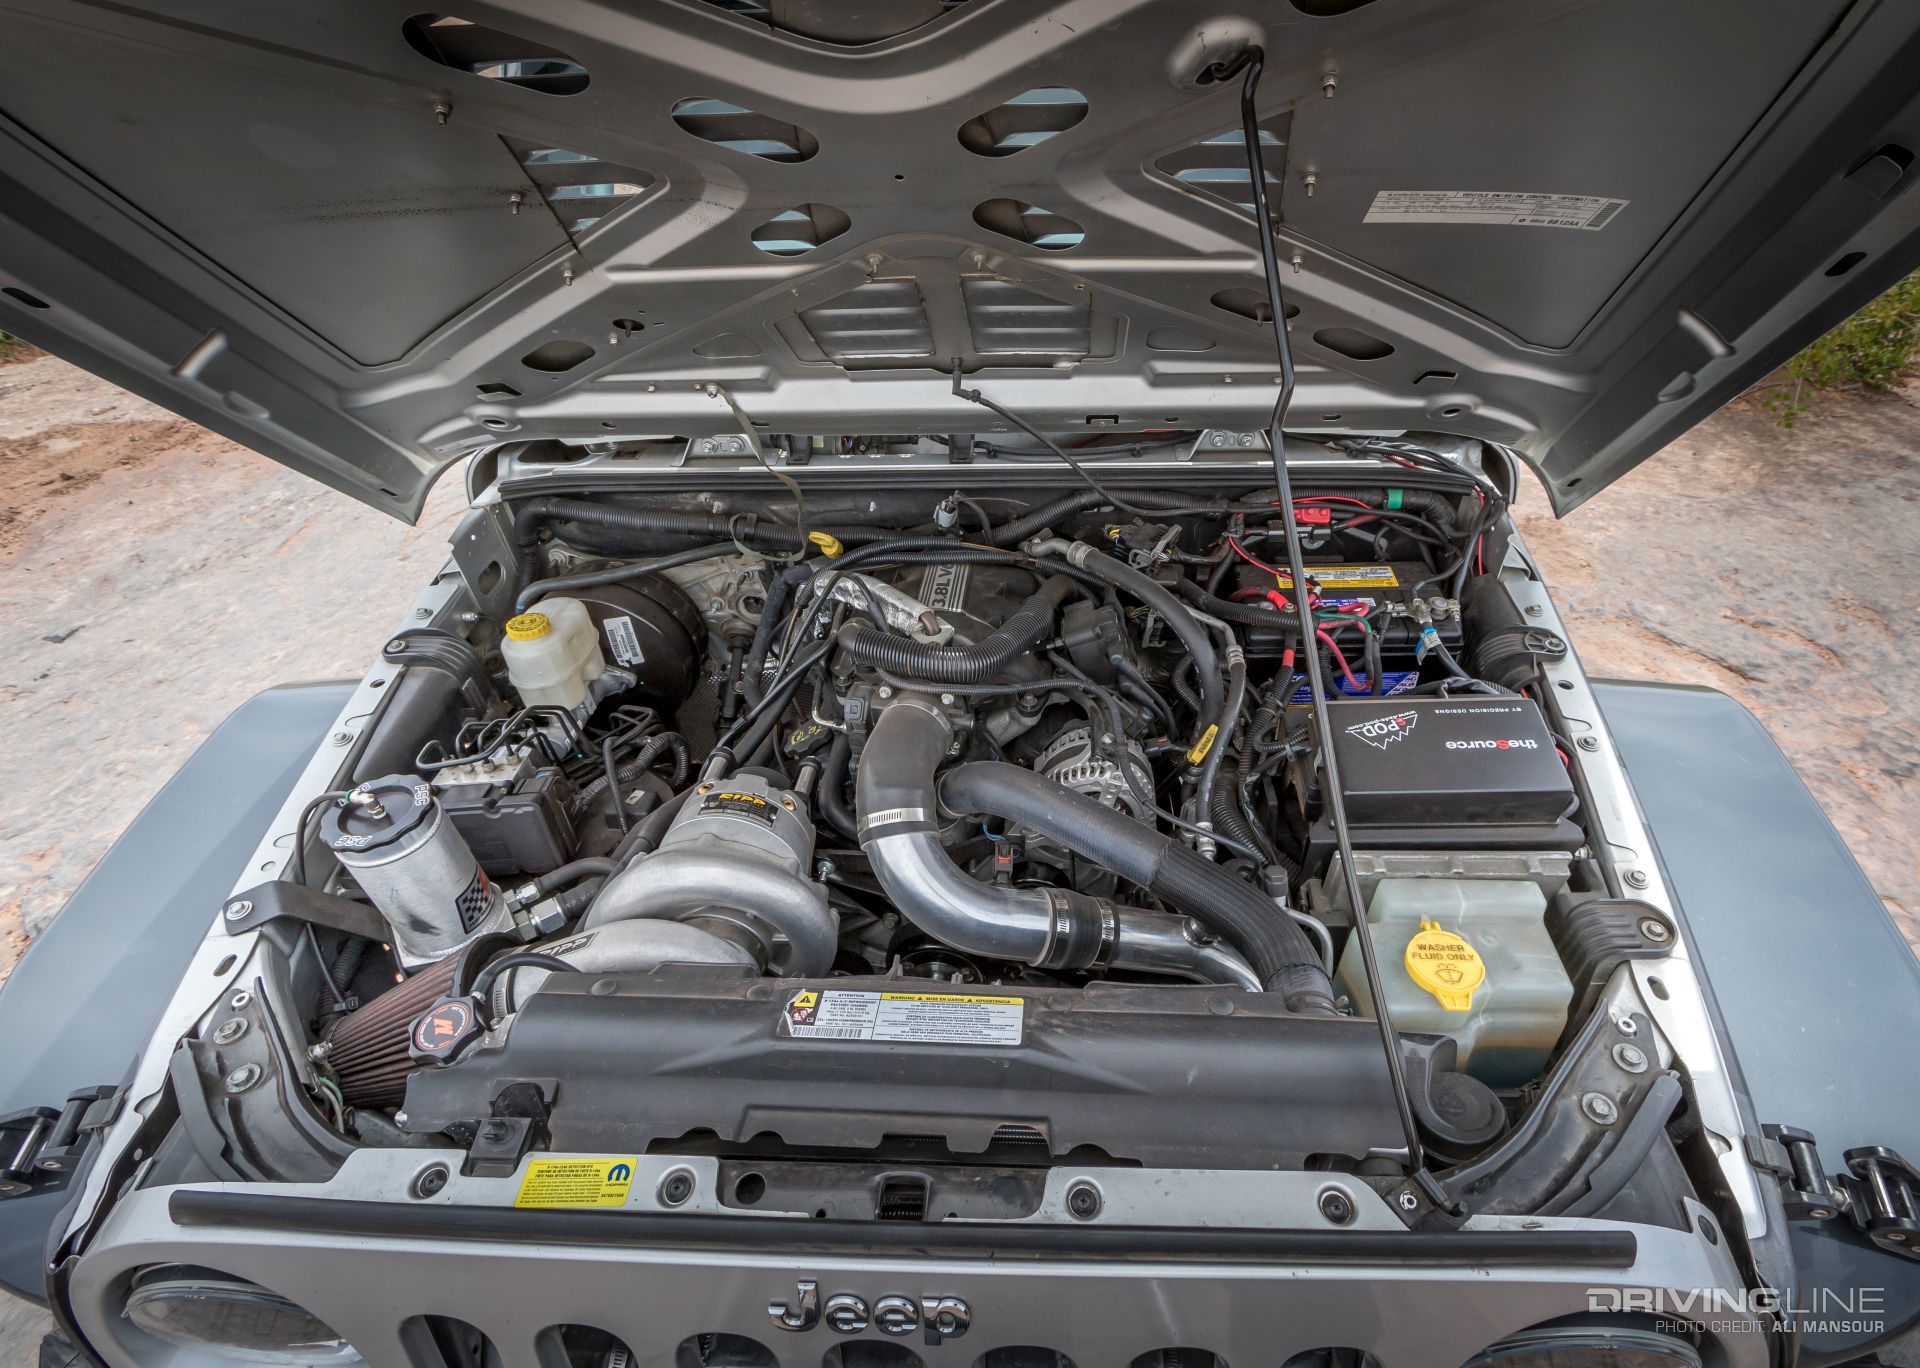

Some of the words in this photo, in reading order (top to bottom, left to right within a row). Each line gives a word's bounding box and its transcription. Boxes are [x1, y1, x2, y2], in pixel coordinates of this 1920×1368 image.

[932, 579, 951, 608] 3.8L
[1445, 739, 1538, 749] theSource
[334, 835, 373, 847] PSC
[1416, 943, 1465, 952] WASHER
[1411, 952, 1444, 960] FLUID
[1446, 953, 1474, 961] ONLY
[768, 1280, 971, 1346] Jeep
